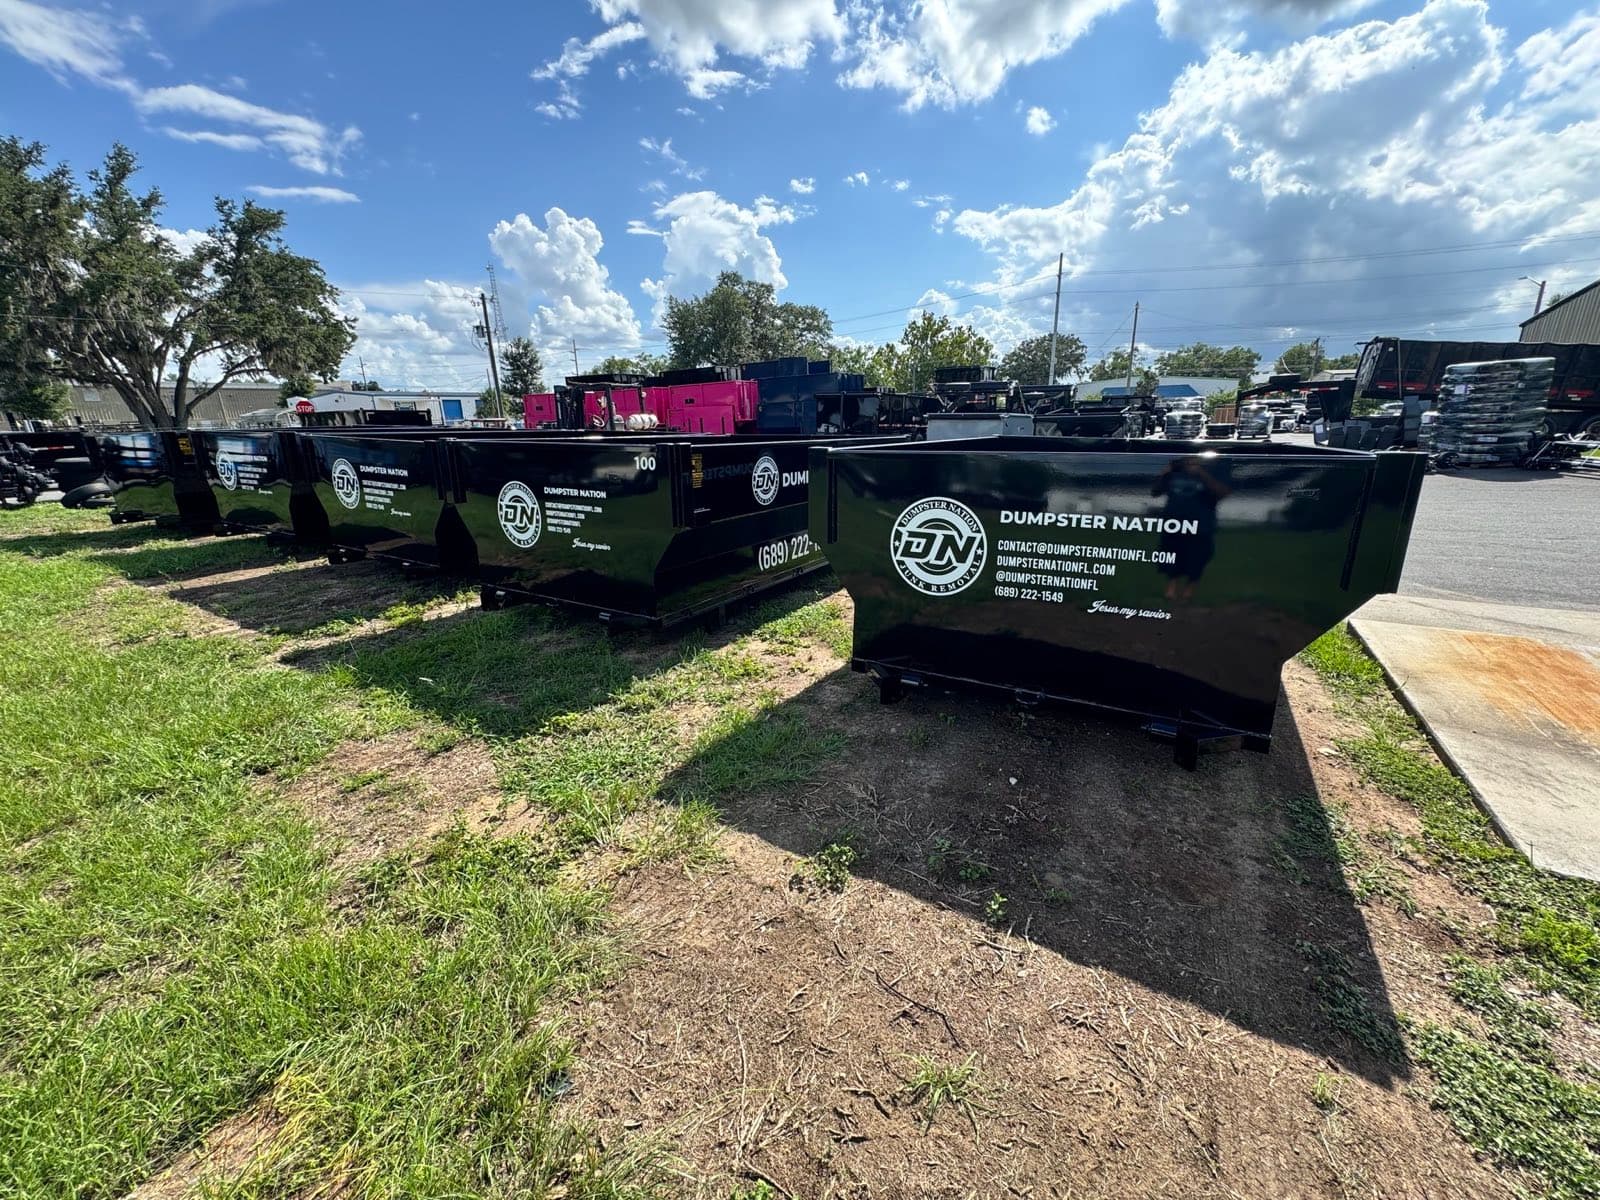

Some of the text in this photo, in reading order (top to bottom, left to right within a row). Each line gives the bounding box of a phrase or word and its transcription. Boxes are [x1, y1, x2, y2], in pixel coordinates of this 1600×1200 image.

[633, 456, 656, 470] 100
[543, 486, 607, 499] DUMPSTER NATION
[502, 502, 537, 527] DN
[901, 501, 979, 532] DUMPSTER NATION
[1000, 510, 1199, 535] DUMPSTER NATION
[758, 540, 789, 571] (689)
[897, 527, 983, 567] DN
[997, 540, 1177, 564] CONTACT@DUMPSTERNATIONFL.COM
[900, 560, 981, 592] JUNK REMOVAL
[996, 555, 1116, 576] DUMPSTERNATIONFL.COM
[995, 570, 1099, 591] @DUMPSTERNATIONFL
[994, 585, 1064, 603] (689) 222-1549
[1087, 600, 1172, 620] Jesus my savior
